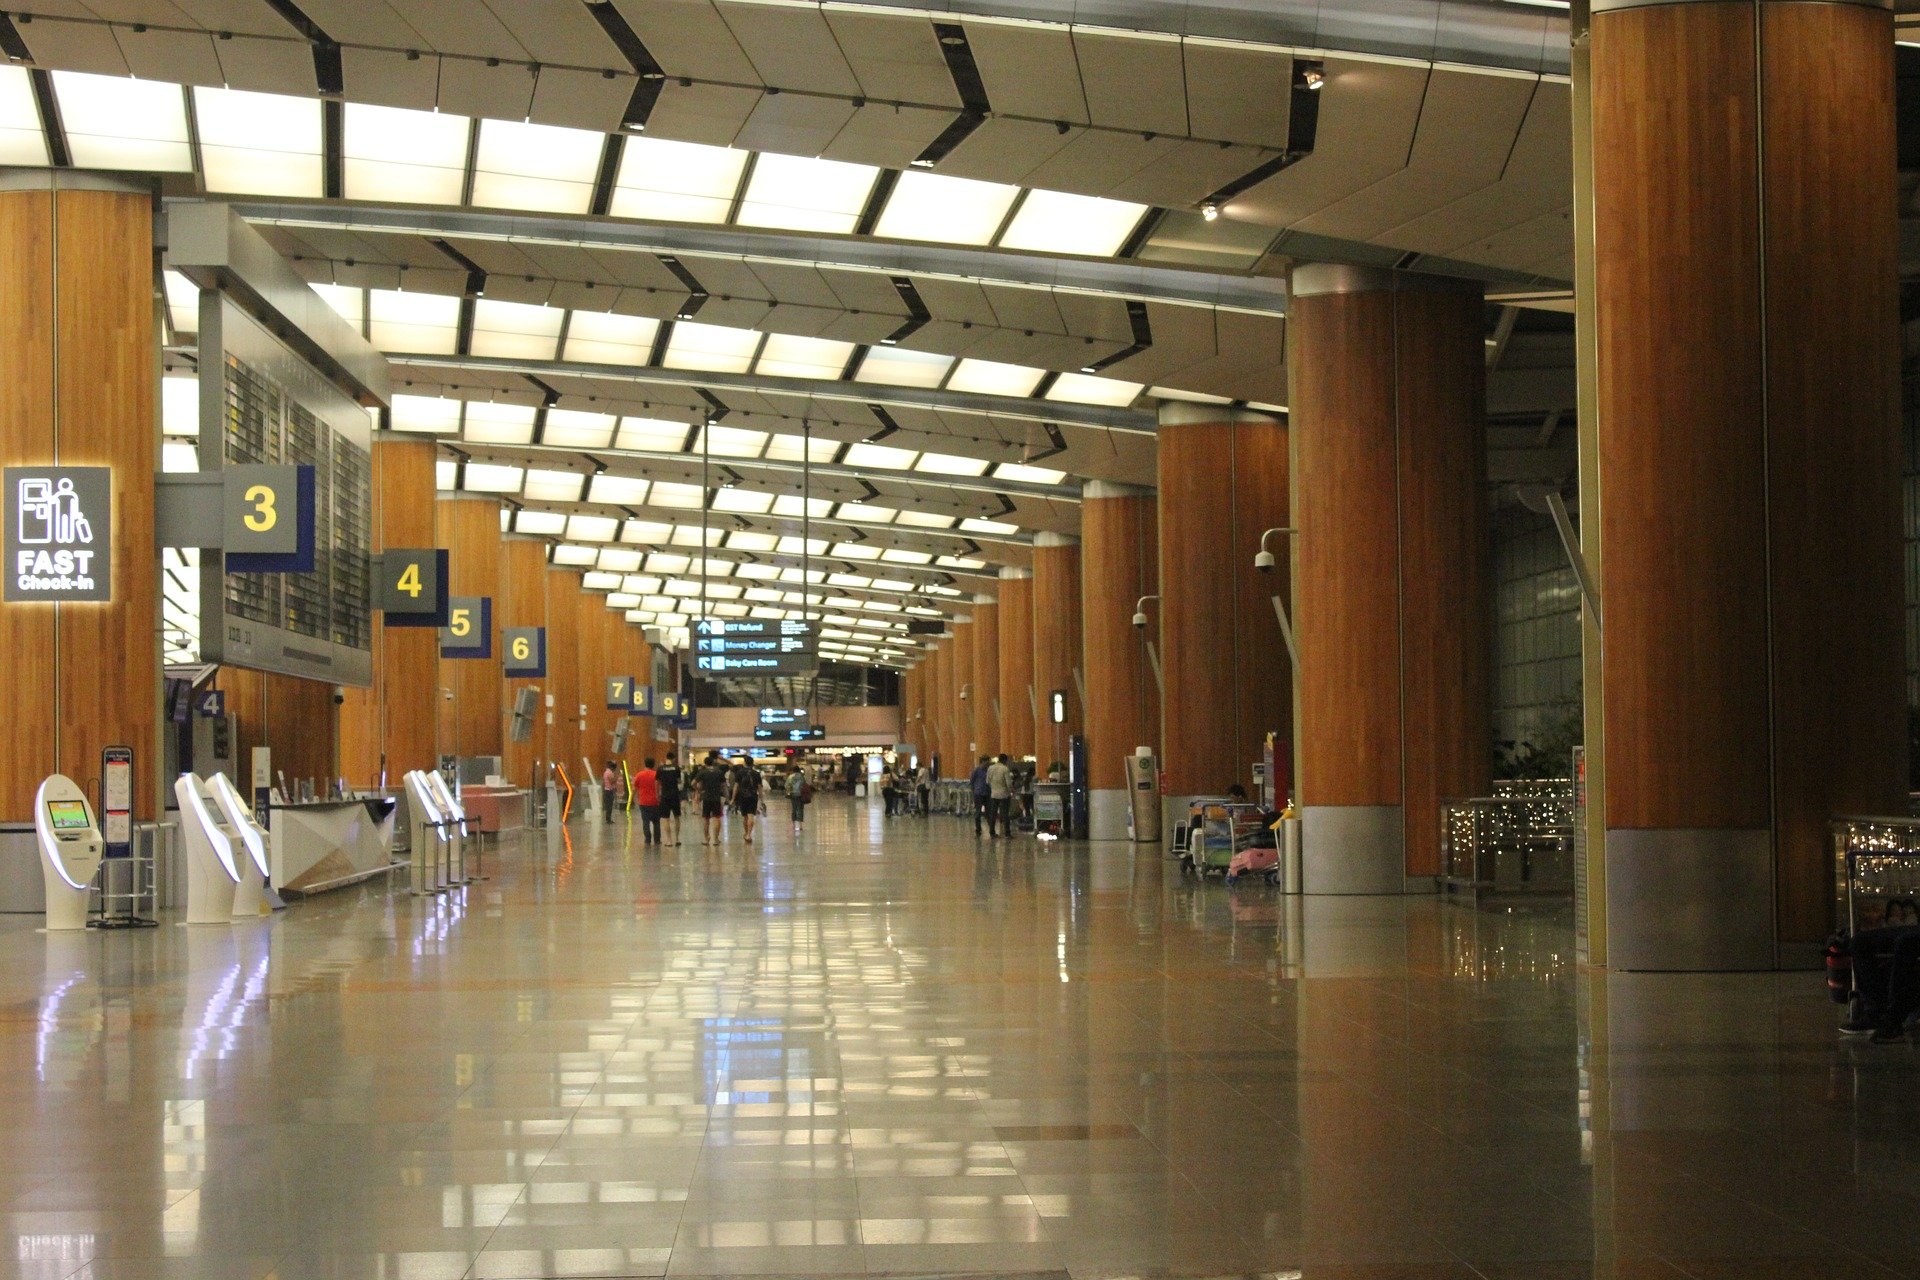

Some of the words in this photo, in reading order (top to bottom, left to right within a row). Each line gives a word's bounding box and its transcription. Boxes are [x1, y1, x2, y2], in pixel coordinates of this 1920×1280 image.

[243, 485, 277, 532] 3
[18, 550, 94, 574] FAST
[397, 564, 422, 597] 4
[451, 609, 470, 636] 5
[725, 623, 738, 631] GST
[739, 623, 763, 631] Refund
[512, 637, 529, 660] 6
[725, 642, 748, 650] Money
[749, 641, 777, 650] Changer
[725, 659, 741, 668] Baby
[742, 659, 757, 667] Care
[612, 682, 624, 698] 7
[633, 690, 643, 705] 8
[203, 693, 220, 715] 4
[663, 697, 674, 710] 9
